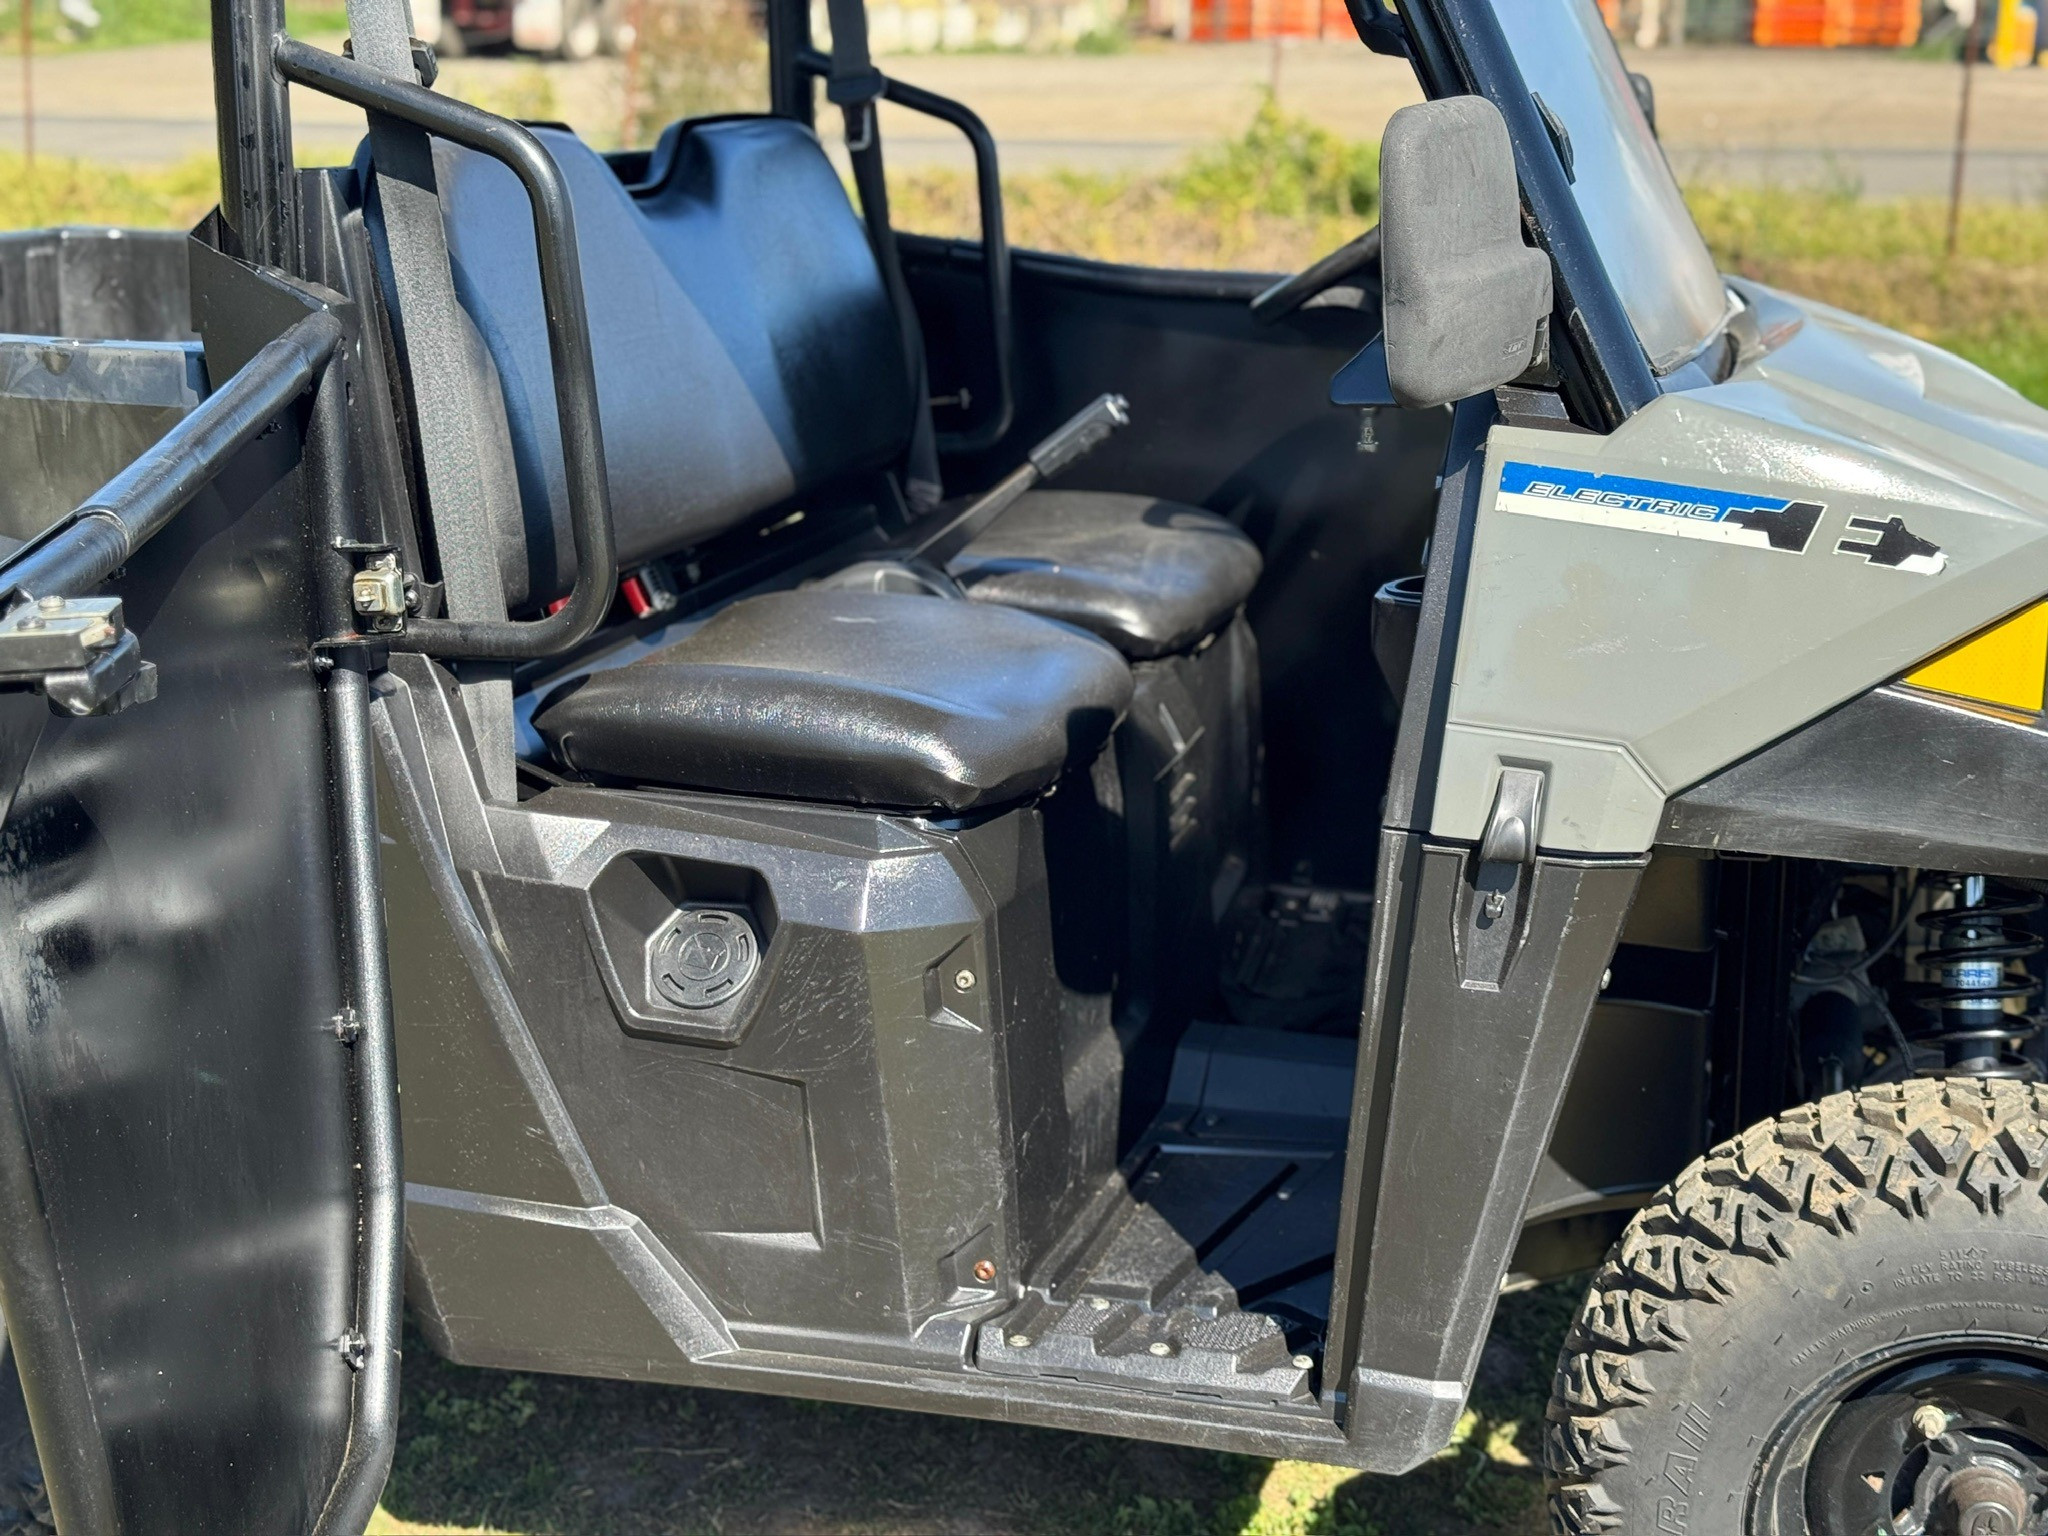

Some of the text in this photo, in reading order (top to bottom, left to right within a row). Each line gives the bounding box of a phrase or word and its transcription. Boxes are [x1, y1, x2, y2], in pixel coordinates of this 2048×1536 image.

[1523, 481, 1719, 520] ELECTRIC
[1911, 1262, 1933, 1274] PLY
[1940, 1259, 1983, 1271] RATING
[1893, 1272, 1942, 1289] INFLATE
[1948, 1271, 1964, 1282] TO
